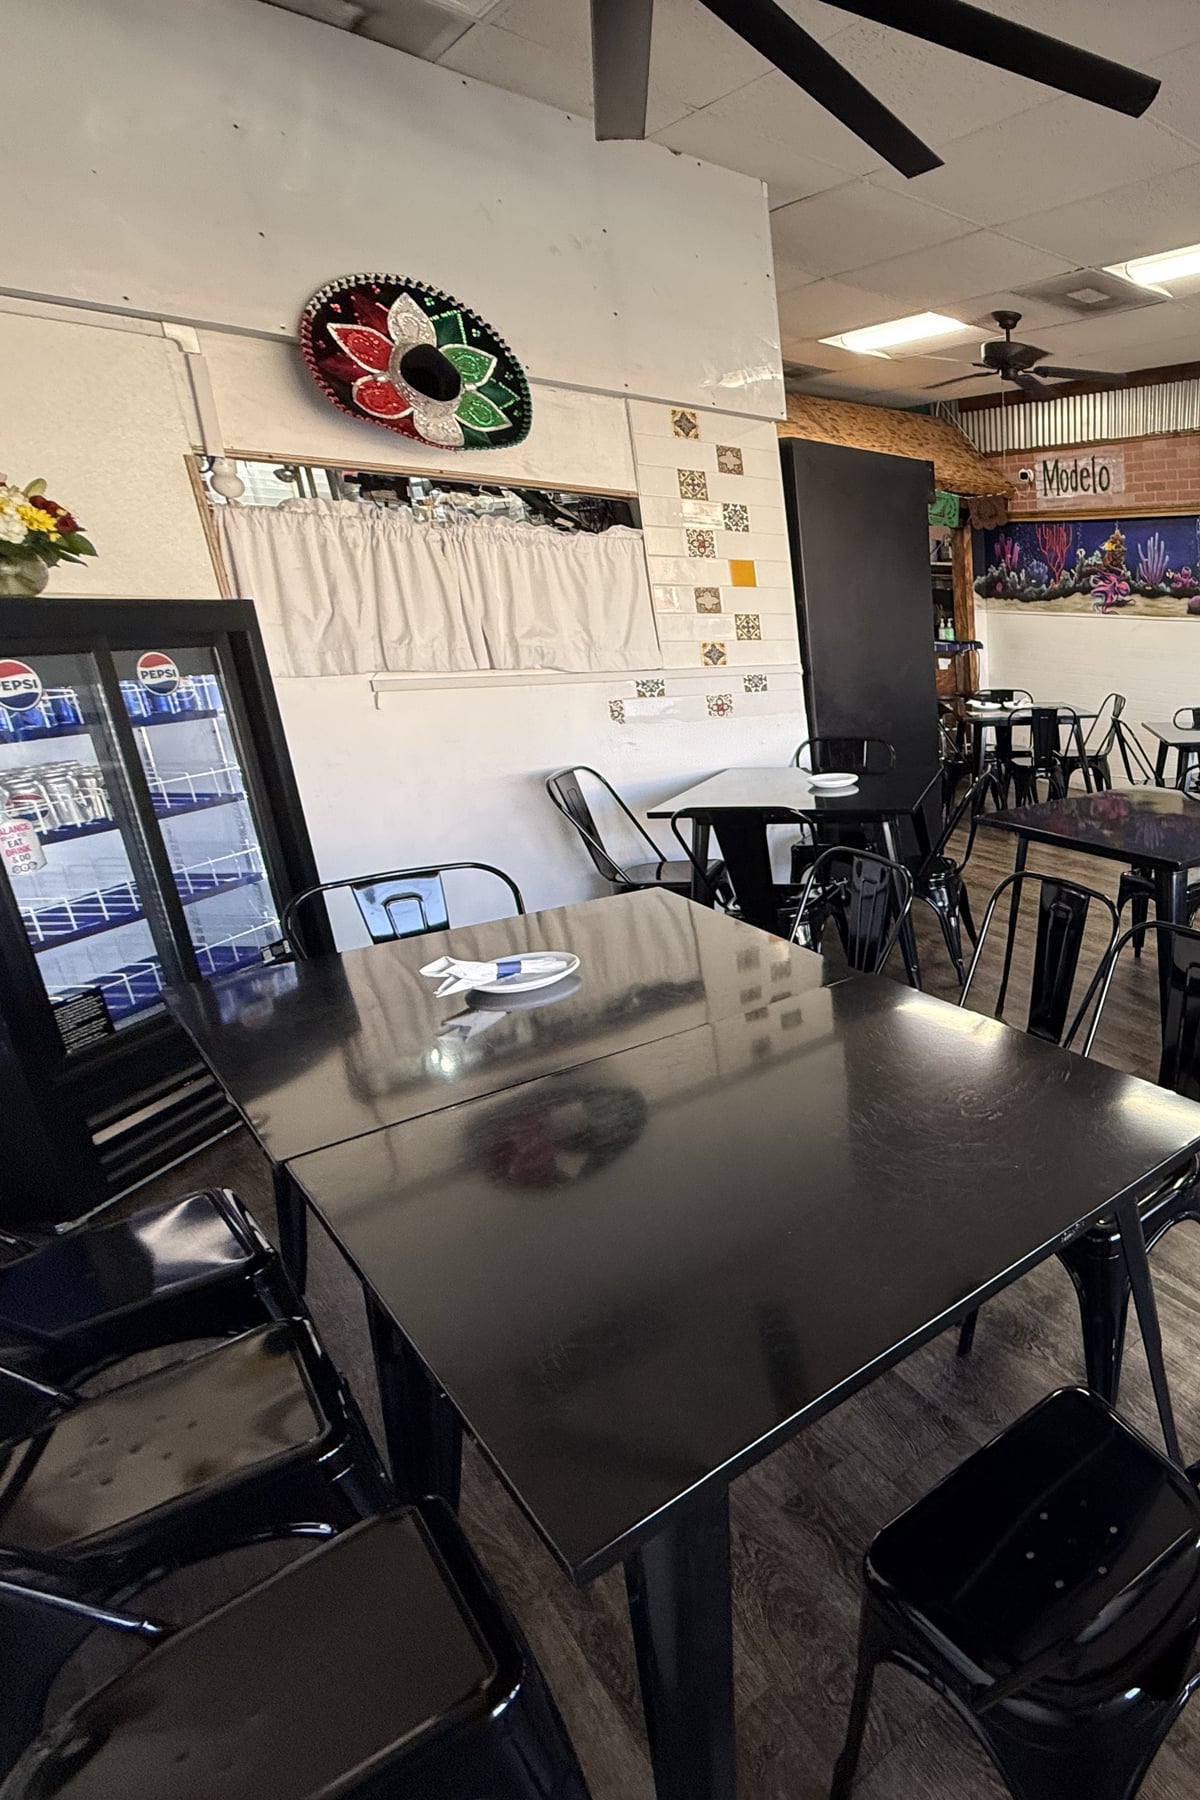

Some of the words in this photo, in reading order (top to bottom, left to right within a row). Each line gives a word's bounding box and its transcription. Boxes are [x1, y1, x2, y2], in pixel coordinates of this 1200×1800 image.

[1043, 455, 1110, 496] Modelo
[141, 669, 177, 679] PEPSI
[0, 679, 38, 691] EPSI
[0, 822, 30, 836] ALANCE
[7, 838, 23, 848] EAT
